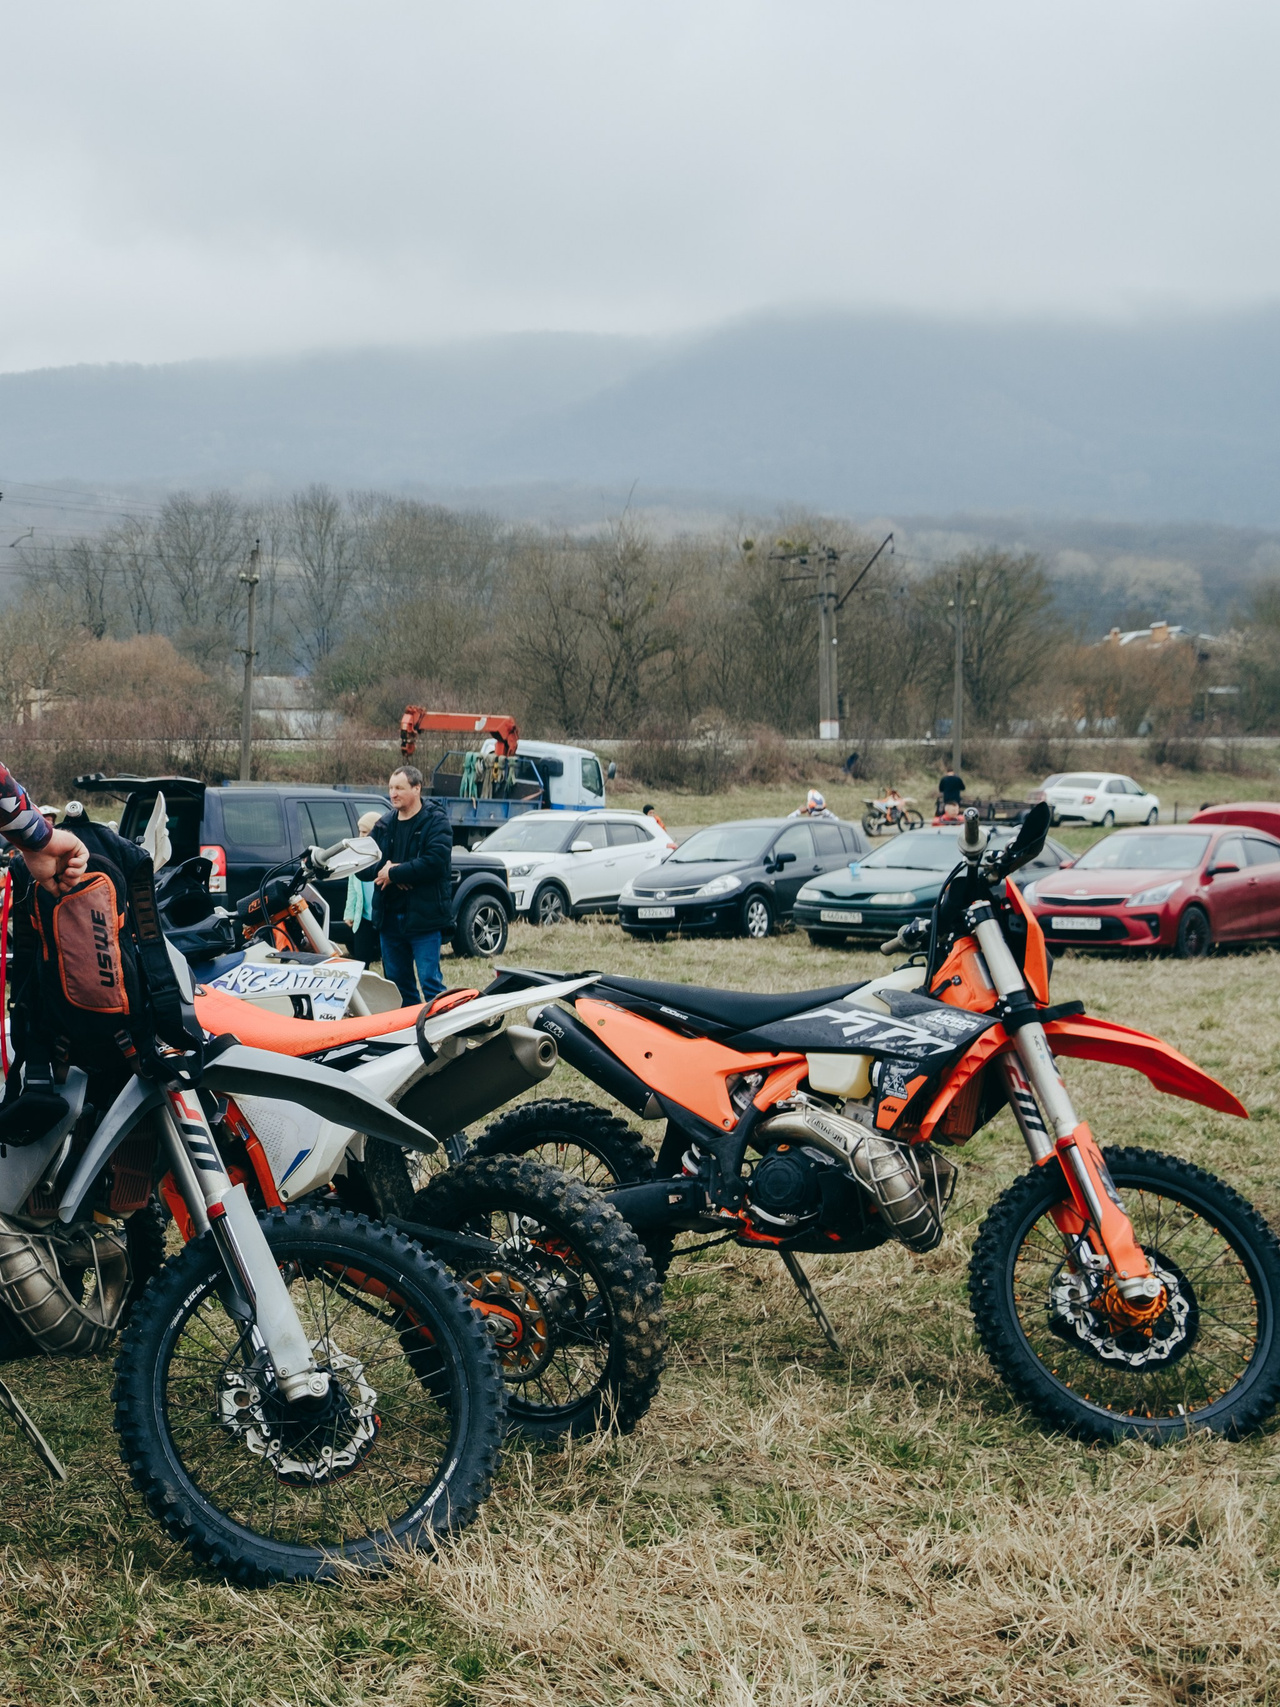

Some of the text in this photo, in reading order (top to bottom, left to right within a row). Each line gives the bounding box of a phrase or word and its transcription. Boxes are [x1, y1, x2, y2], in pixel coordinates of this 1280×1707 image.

[91, 909, 115, 988] USWE
[319, 1013, 337, 1021] KTM
[543, 1020, 565, 1038] KTM
[882, 1105, 898, 1114] KTM
[183, 1284, 207, 1308] EXCEL
